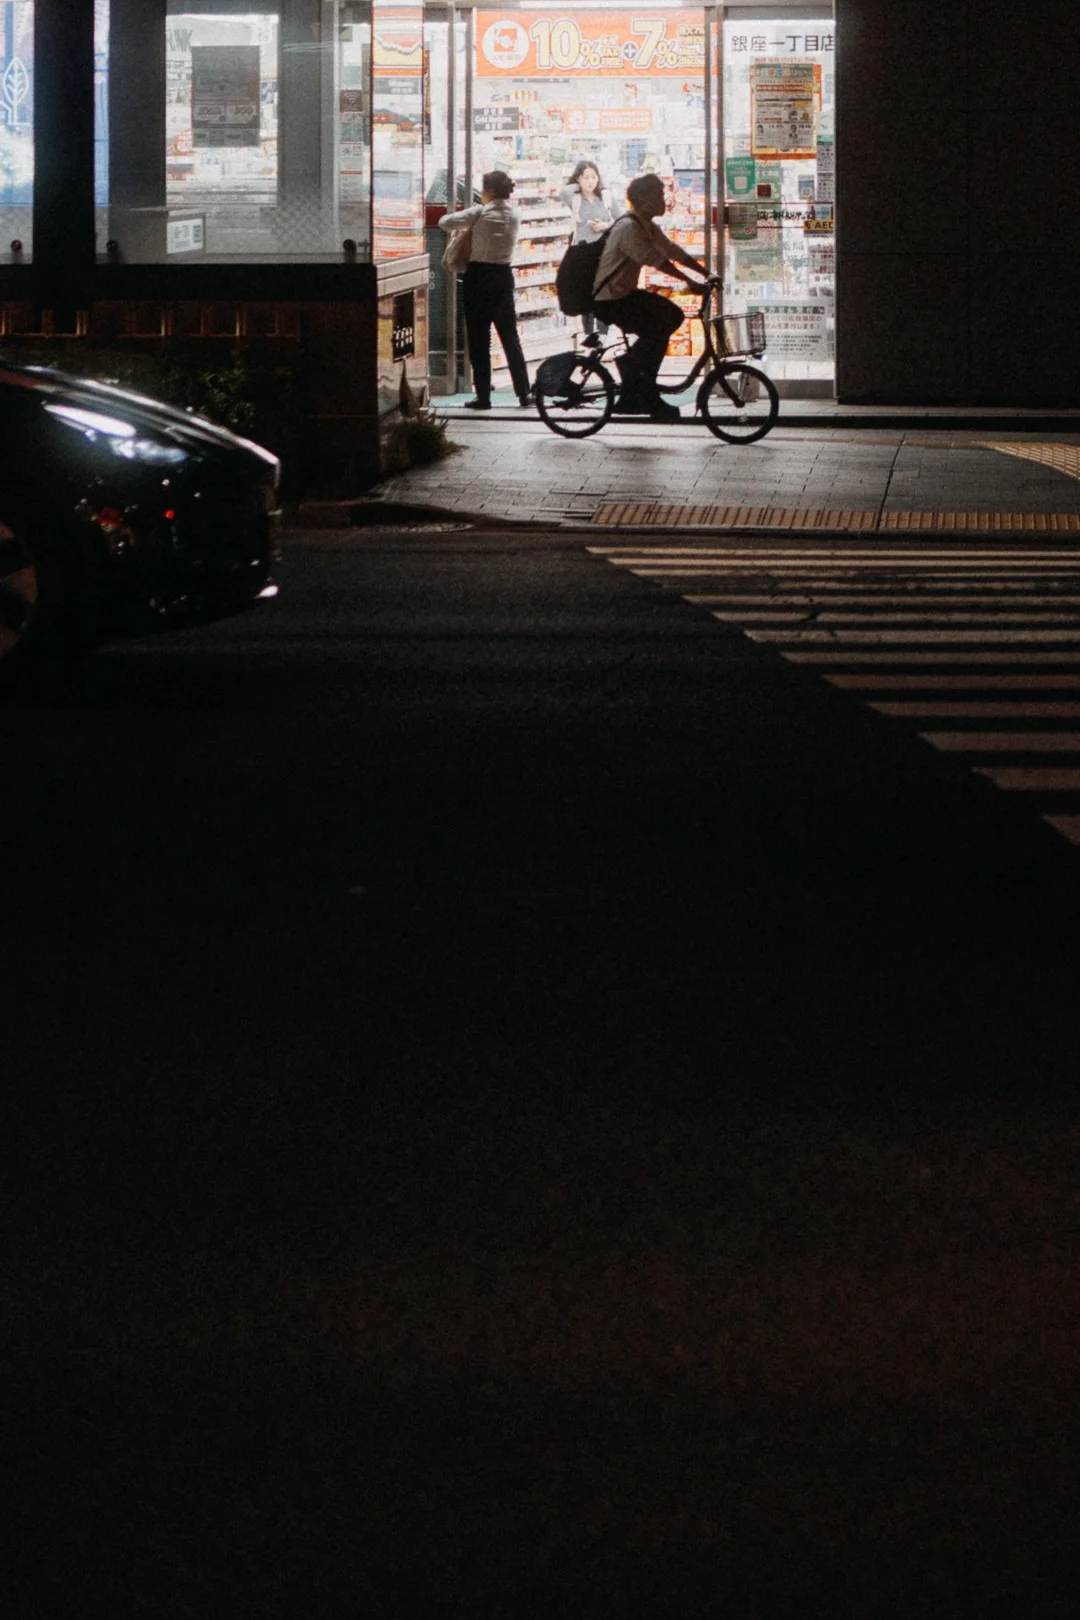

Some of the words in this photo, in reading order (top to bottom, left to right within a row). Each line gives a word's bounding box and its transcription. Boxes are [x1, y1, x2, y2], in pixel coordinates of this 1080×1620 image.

[731, 34, 835, 52] 銀座一丁目店
